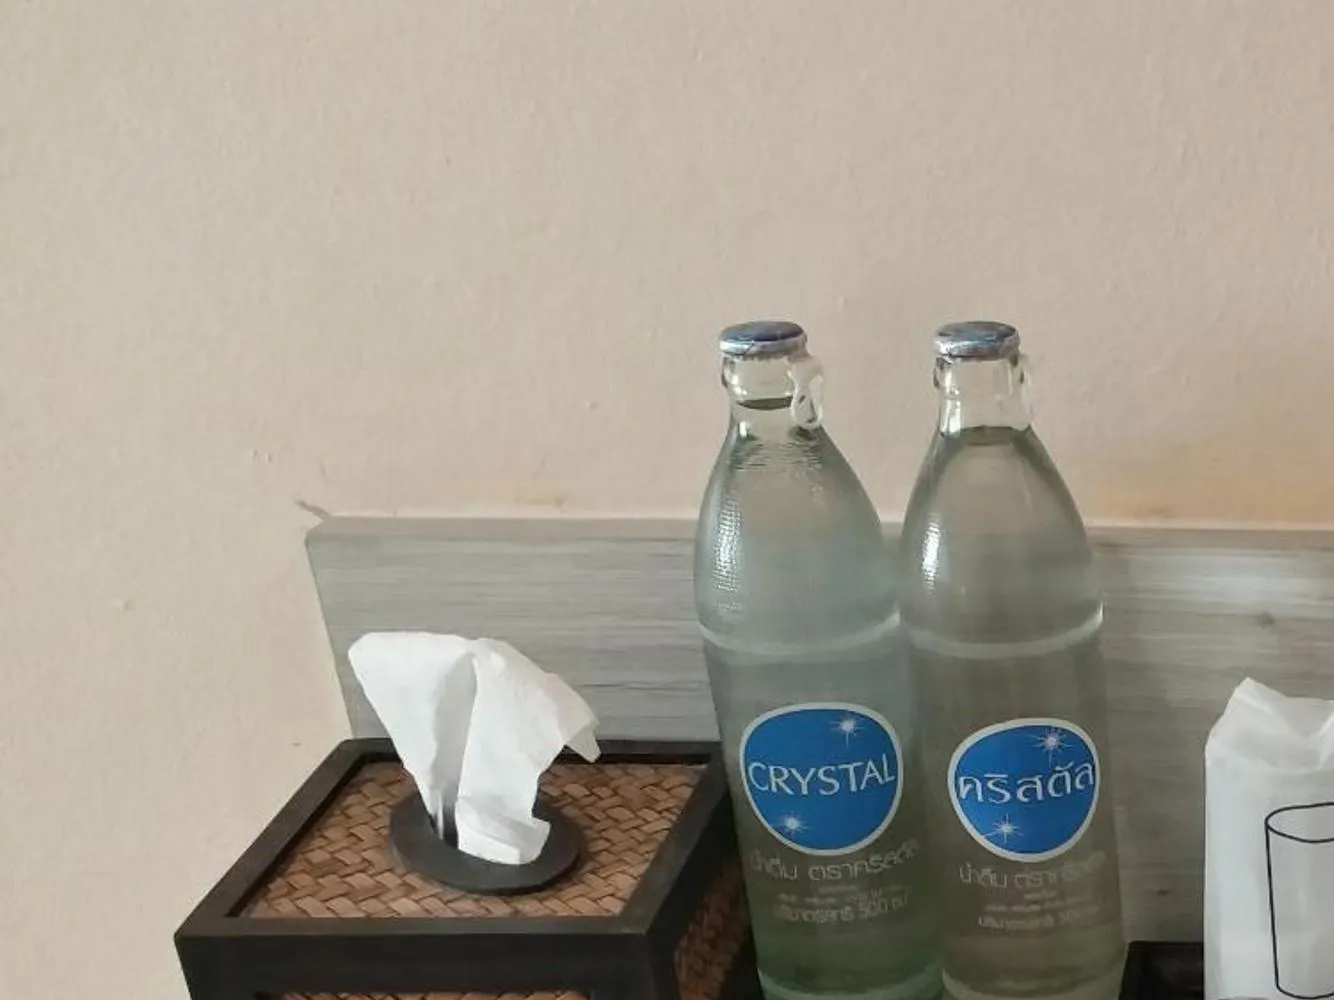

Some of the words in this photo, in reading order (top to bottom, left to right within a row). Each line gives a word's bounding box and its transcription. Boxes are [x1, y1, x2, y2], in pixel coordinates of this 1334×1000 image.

[747, 754, 897, 797] CRYSTAL
[957, 762, 1095, 804] คริสตัล
